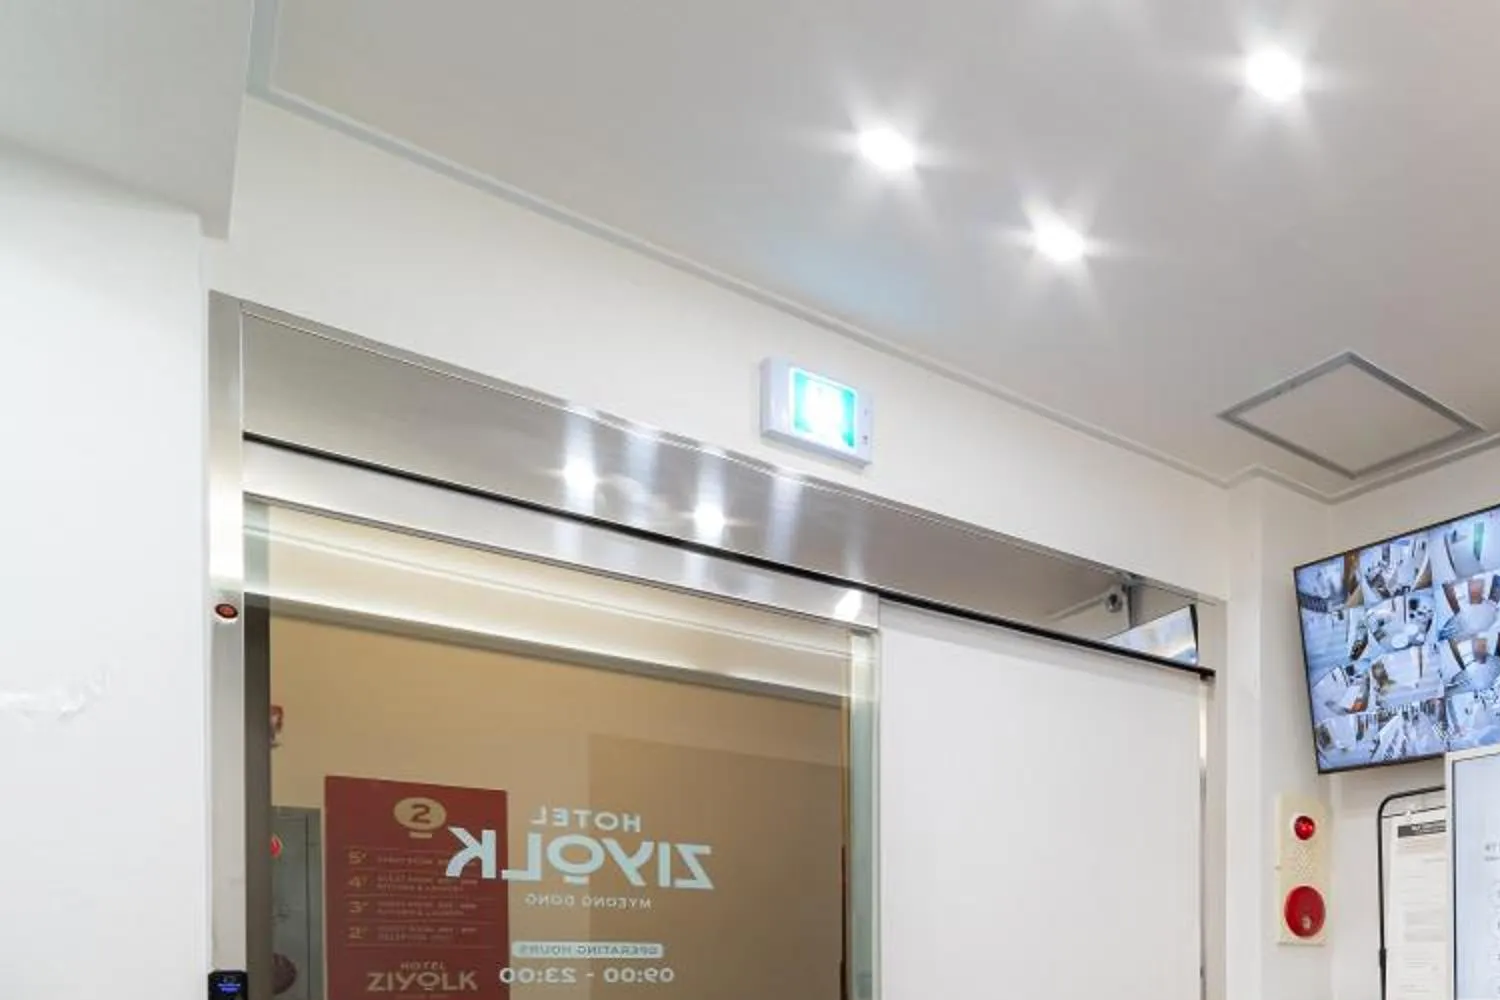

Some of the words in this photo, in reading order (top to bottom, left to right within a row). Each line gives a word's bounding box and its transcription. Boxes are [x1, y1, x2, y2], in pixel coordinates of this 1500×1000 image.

[411, 803, 431, 824] 2
[400, 960, 447, 971] HOTEL
[366, 971, 479, 992] ZIYOLK
